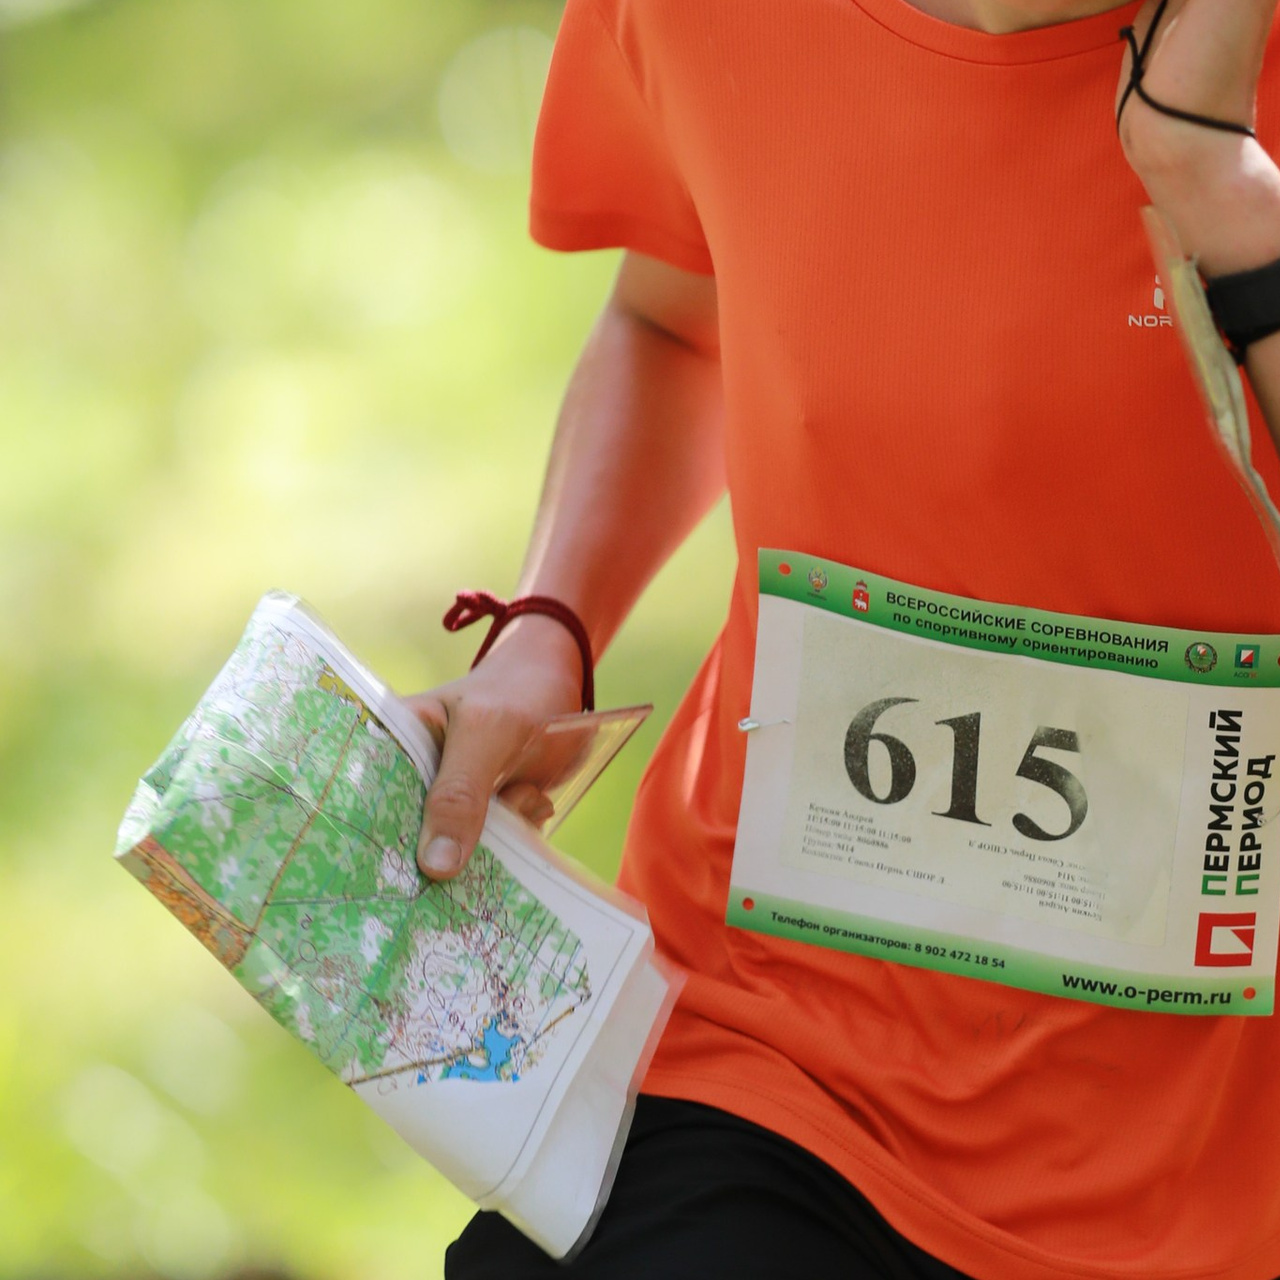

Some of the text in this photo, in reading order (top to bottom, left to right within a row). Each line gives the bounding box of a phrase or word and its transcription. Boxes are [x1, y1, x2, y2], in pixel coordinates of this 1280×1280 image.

[1128, 315, 1173, 327] NOR
[886, 592, 1169, 653] ВСЕРОССИЙСКИЕ СОРЕВНОВАНИЯ
[893, 613, 911, 624] по
[915, 618, 1018, 648] спортивному
[1023, 638, 1158, 668] ориентированию
[843, 696, 1089, 842] 615
[1201, 709, 1243, 896] ПЕРМСКИЙ
[1235, 754, 1276, 896] ПЕРИОД
[843, 822, 876, 834] 11:15:00
[878, 830, 912, 843] 11:15:00
[770, 911, 1006, 969] Телефон организаторов: 8 902 472 18 54
[1062, 974, 1232, 1005] www.o-perm.ru
